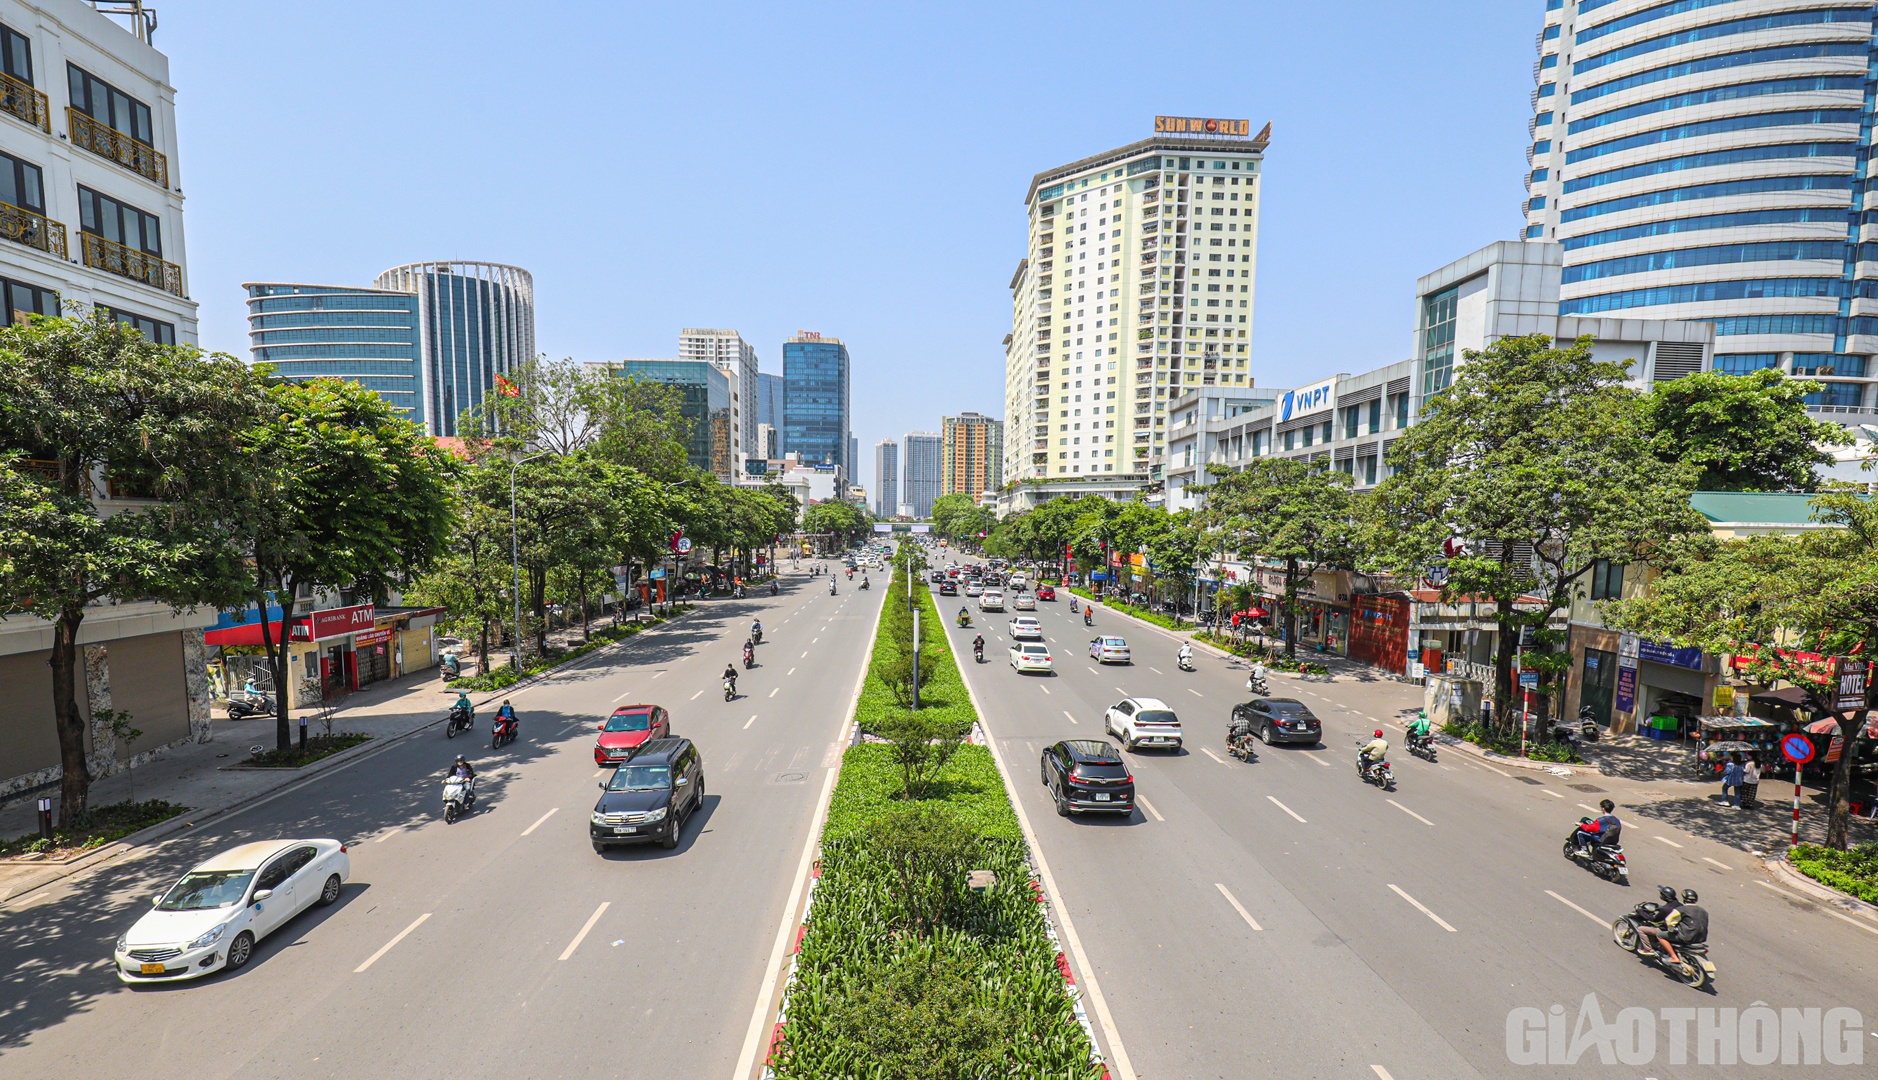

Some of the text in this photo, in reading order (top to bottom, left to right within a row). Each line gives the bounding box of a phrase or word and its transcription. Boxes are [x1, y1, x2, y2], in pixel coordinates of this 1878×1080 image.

[1155, 116, 1187, 132] SUN
[1297, 385, 1330, 412] VNPT
[351, 608, 373, 625] ATM
[292, 625, 309, 636] ATM
[1840, 673, 1865, 695] HOTEL
